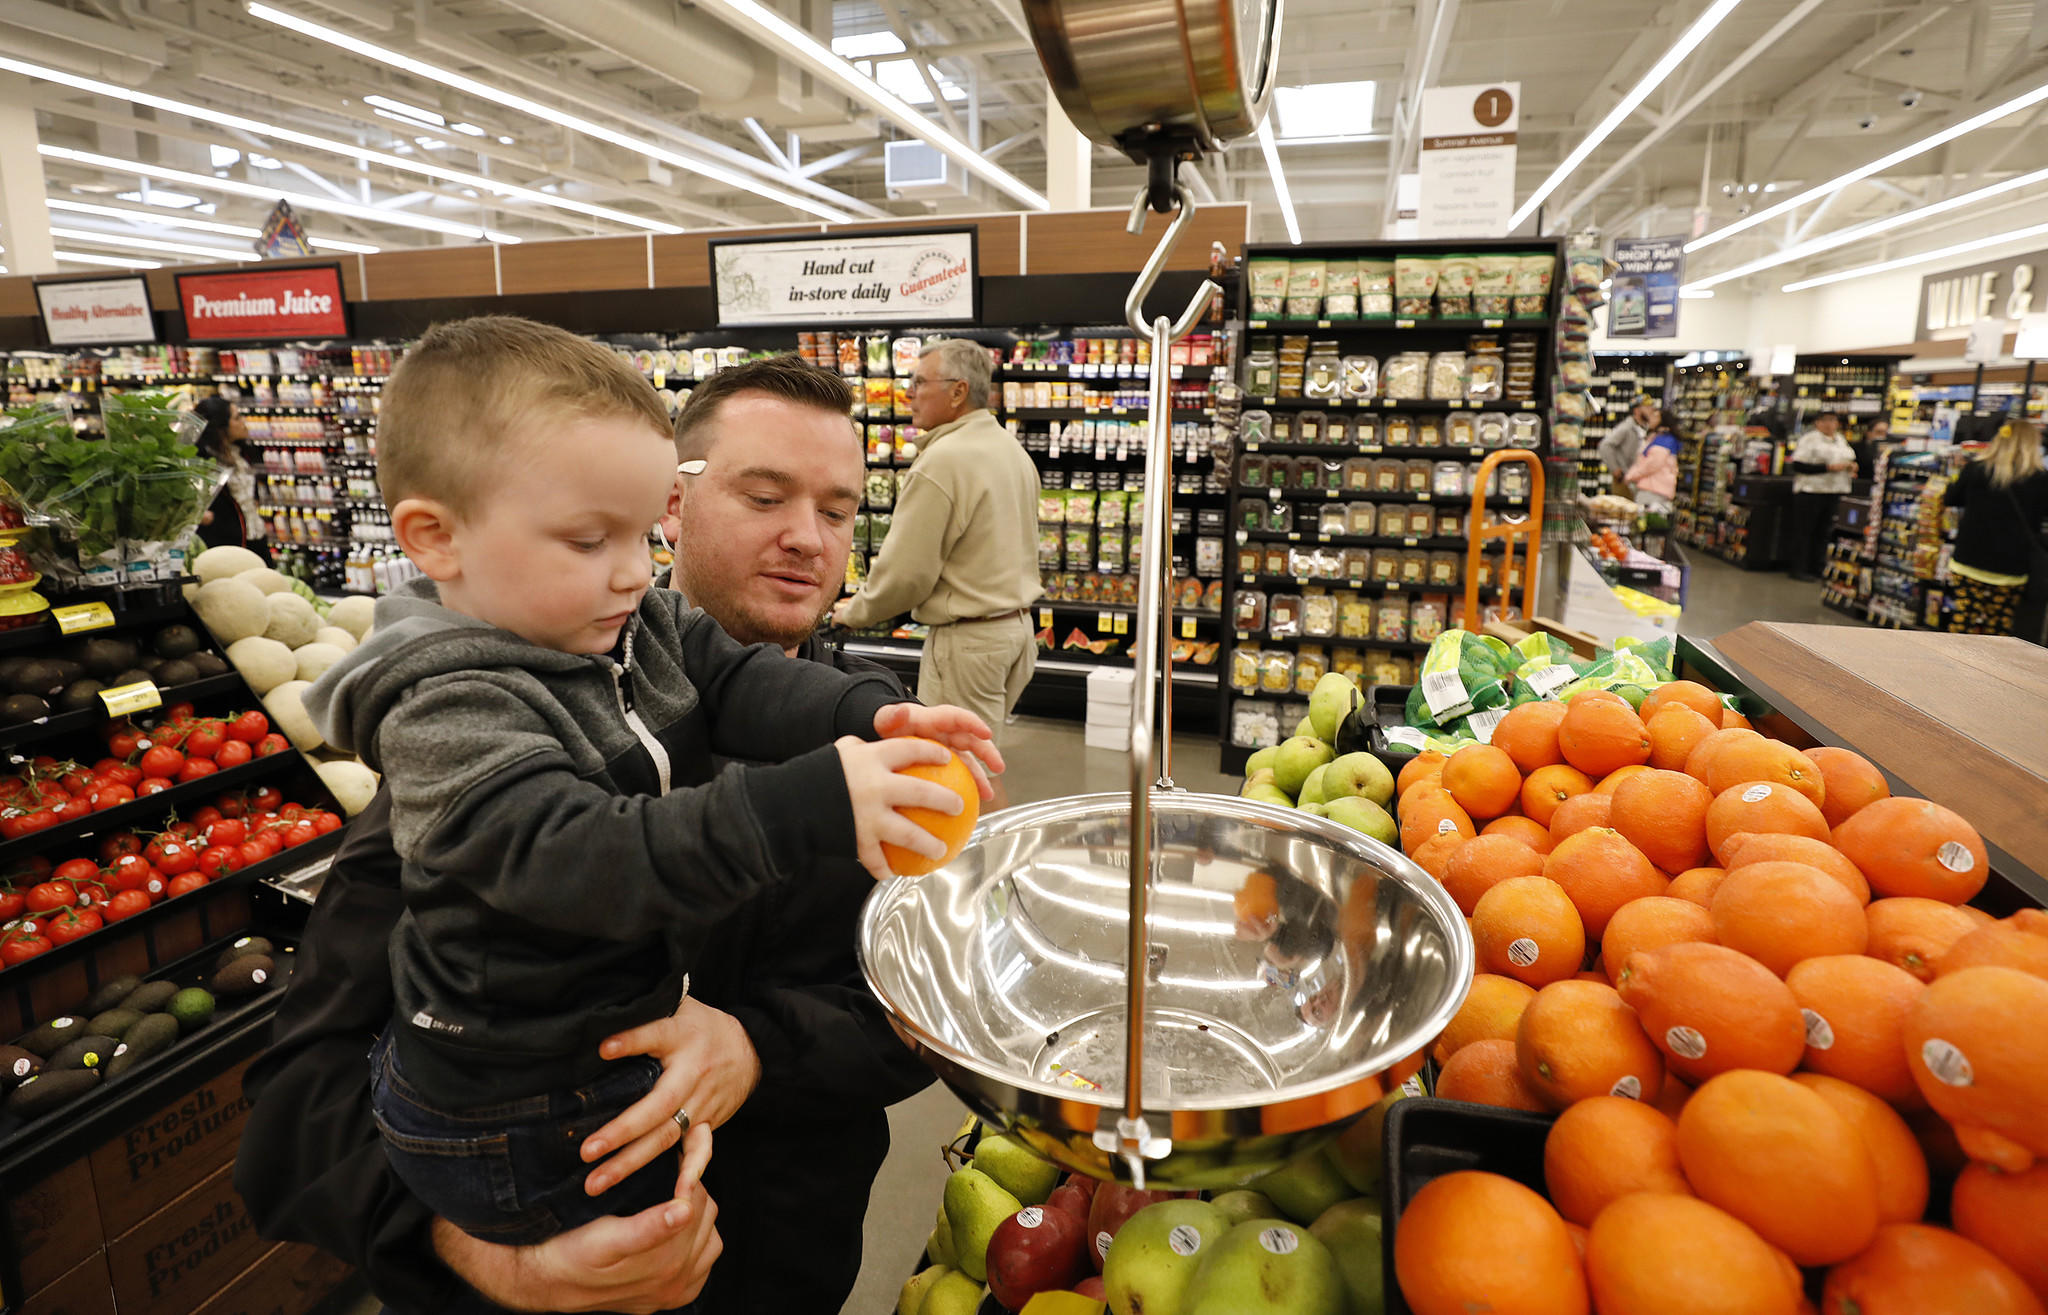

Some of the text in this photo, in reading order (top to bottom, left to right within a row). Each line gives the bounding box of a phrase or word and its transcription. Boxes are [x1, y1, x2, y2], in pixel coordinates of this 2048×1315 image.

[1490, 96, 1499, 118] 1
[1469, 135, 1505, 146] Avenue
[802, 258, 875, 276] Hand cut
[900, 258, 968, 298] Guaranteed
[192, 288, 332, 319] Premium Juice
[788, 283, 891, 303] in-store daily
[2006, 263, 2034, 320] &
[51, 304, 89, 323] Healthy
[123, 1086, 217, 1157] Fresh
[144, 1199, 234, 1276] Fresh
[149, 1212, 256, 1298] Produc
